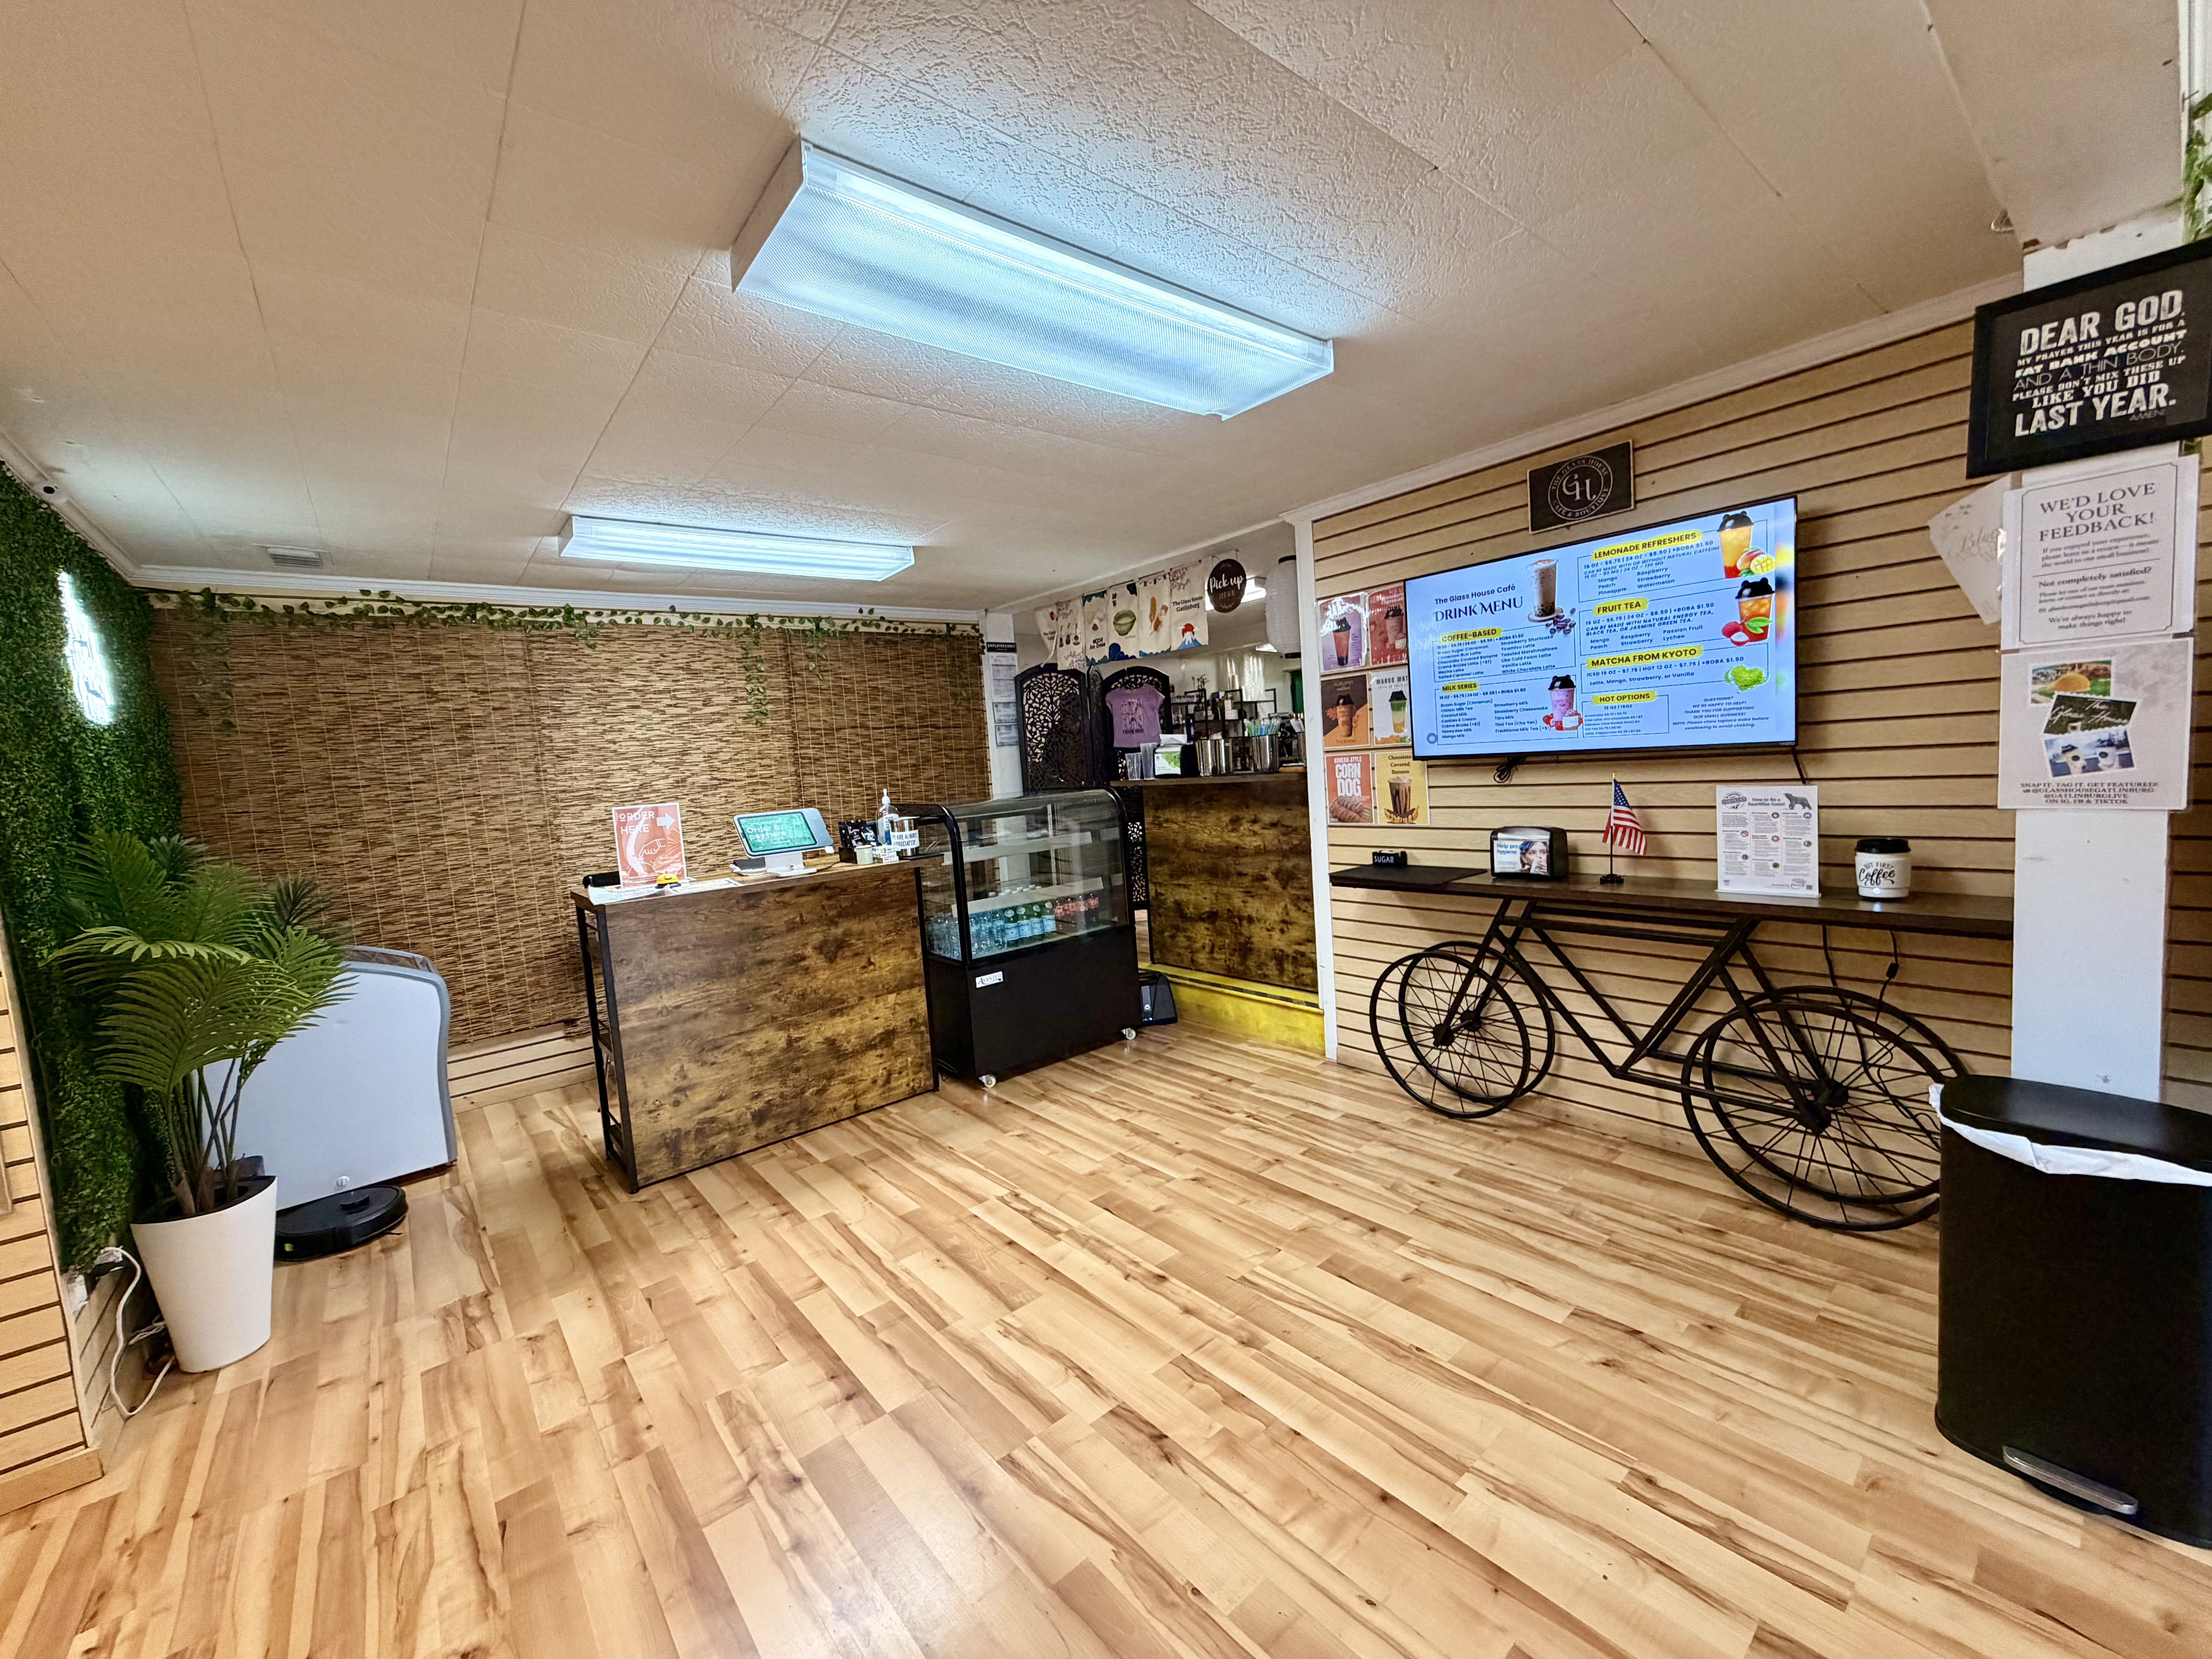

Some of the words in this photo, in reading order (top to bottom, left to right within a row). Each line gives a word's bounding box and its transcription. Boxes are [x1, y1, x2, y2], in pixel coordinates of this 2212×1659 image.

[2020, 312, 2100, 356] DEAR
[2015, 364, 2043, 378] FAT
[2049, 351, 2097, 370] BANK
[2104, 329, 2187, 357] ACCOUNT
[2018, 357, 2032, 366] MY
[2035, 347, 2074, 362] PRAYER
[2078, 340, 2101, 351] THIS
[2106, 332, 2133, 344] YEAR
[2138, 328, 2148, 337] IS
[2152, 322, 2171, 333] FOR
[2013, 386, 2053, 401] PLEASE
[2058, 373, 2091, 391] DON'T
[2095, 371, 2118, 382] MIX
[2124, 361, 2163, 376] THESE
[2169, 356, 2186, 366] UP
[2014, 373, 2052, 391] AND
[2059, 368, 2072, 381] A
[2081, 356, 2118, 374] THIN
[2032, 390, 2074, 408] LIKE
[2082, 380, 2118, 397] YOU
[2126, 370, 2160, 388] DID
[2015, 400, 2083, 437] LAST
[2092, 383, 2176, 420] YEAR.
[2040, 496, 2090, 513] WE'D
[2098, 483, 2155, 503] LOVE
[2066, 503, 2125, 522] YOUR
[2040, 512, 2153, 541] FEEDBACK!
[1595, 544, 1639, 558] LEMONADE
[1642, 532, 1696, 549] REFRESHERS
[1637, 567, 1668, 576] Raspberry
[1637, 574, 1671, 582] Strawberry
[2057, 573, 2107, 585] completely
[2110, 566, 2152, 578] satisfied?
[1210, 574, 1229, 594] Pick
[1230, 575, 1244, 590] up
[1471, 589, 1495, 598] House
[1497, 584, 1515, 593] Café
[1599, 587, 1626, 596] Pineapple
[1637, 579, 1675, 589] Watermelon
[1219, 590, 1235, 599] HERE
[1433, 605, 1477, 621] DRINK
[1479, 596, 1523, 615] MENU
[1598, 604, 1622, 614] FRUIT
[1624, 601, 1641, 610] TEA
[1442, 629, 1496, 641] COFFEE-BASED
[1592, 656, 1630, 666] MATCHA
[1633, 653, 1659, 662] FROM
[1662, 649, 1697, 659] KYOTO
[2085, 699, 2111, 711] The
[1335, 763, 1361, 779] CORN
[1337, 778, 1361, 797] DOG
[619, 811, 655, 822] ORDER
[620, 824, 649, 835] HERE
[1859, 868, 1895, 886] Coffee
